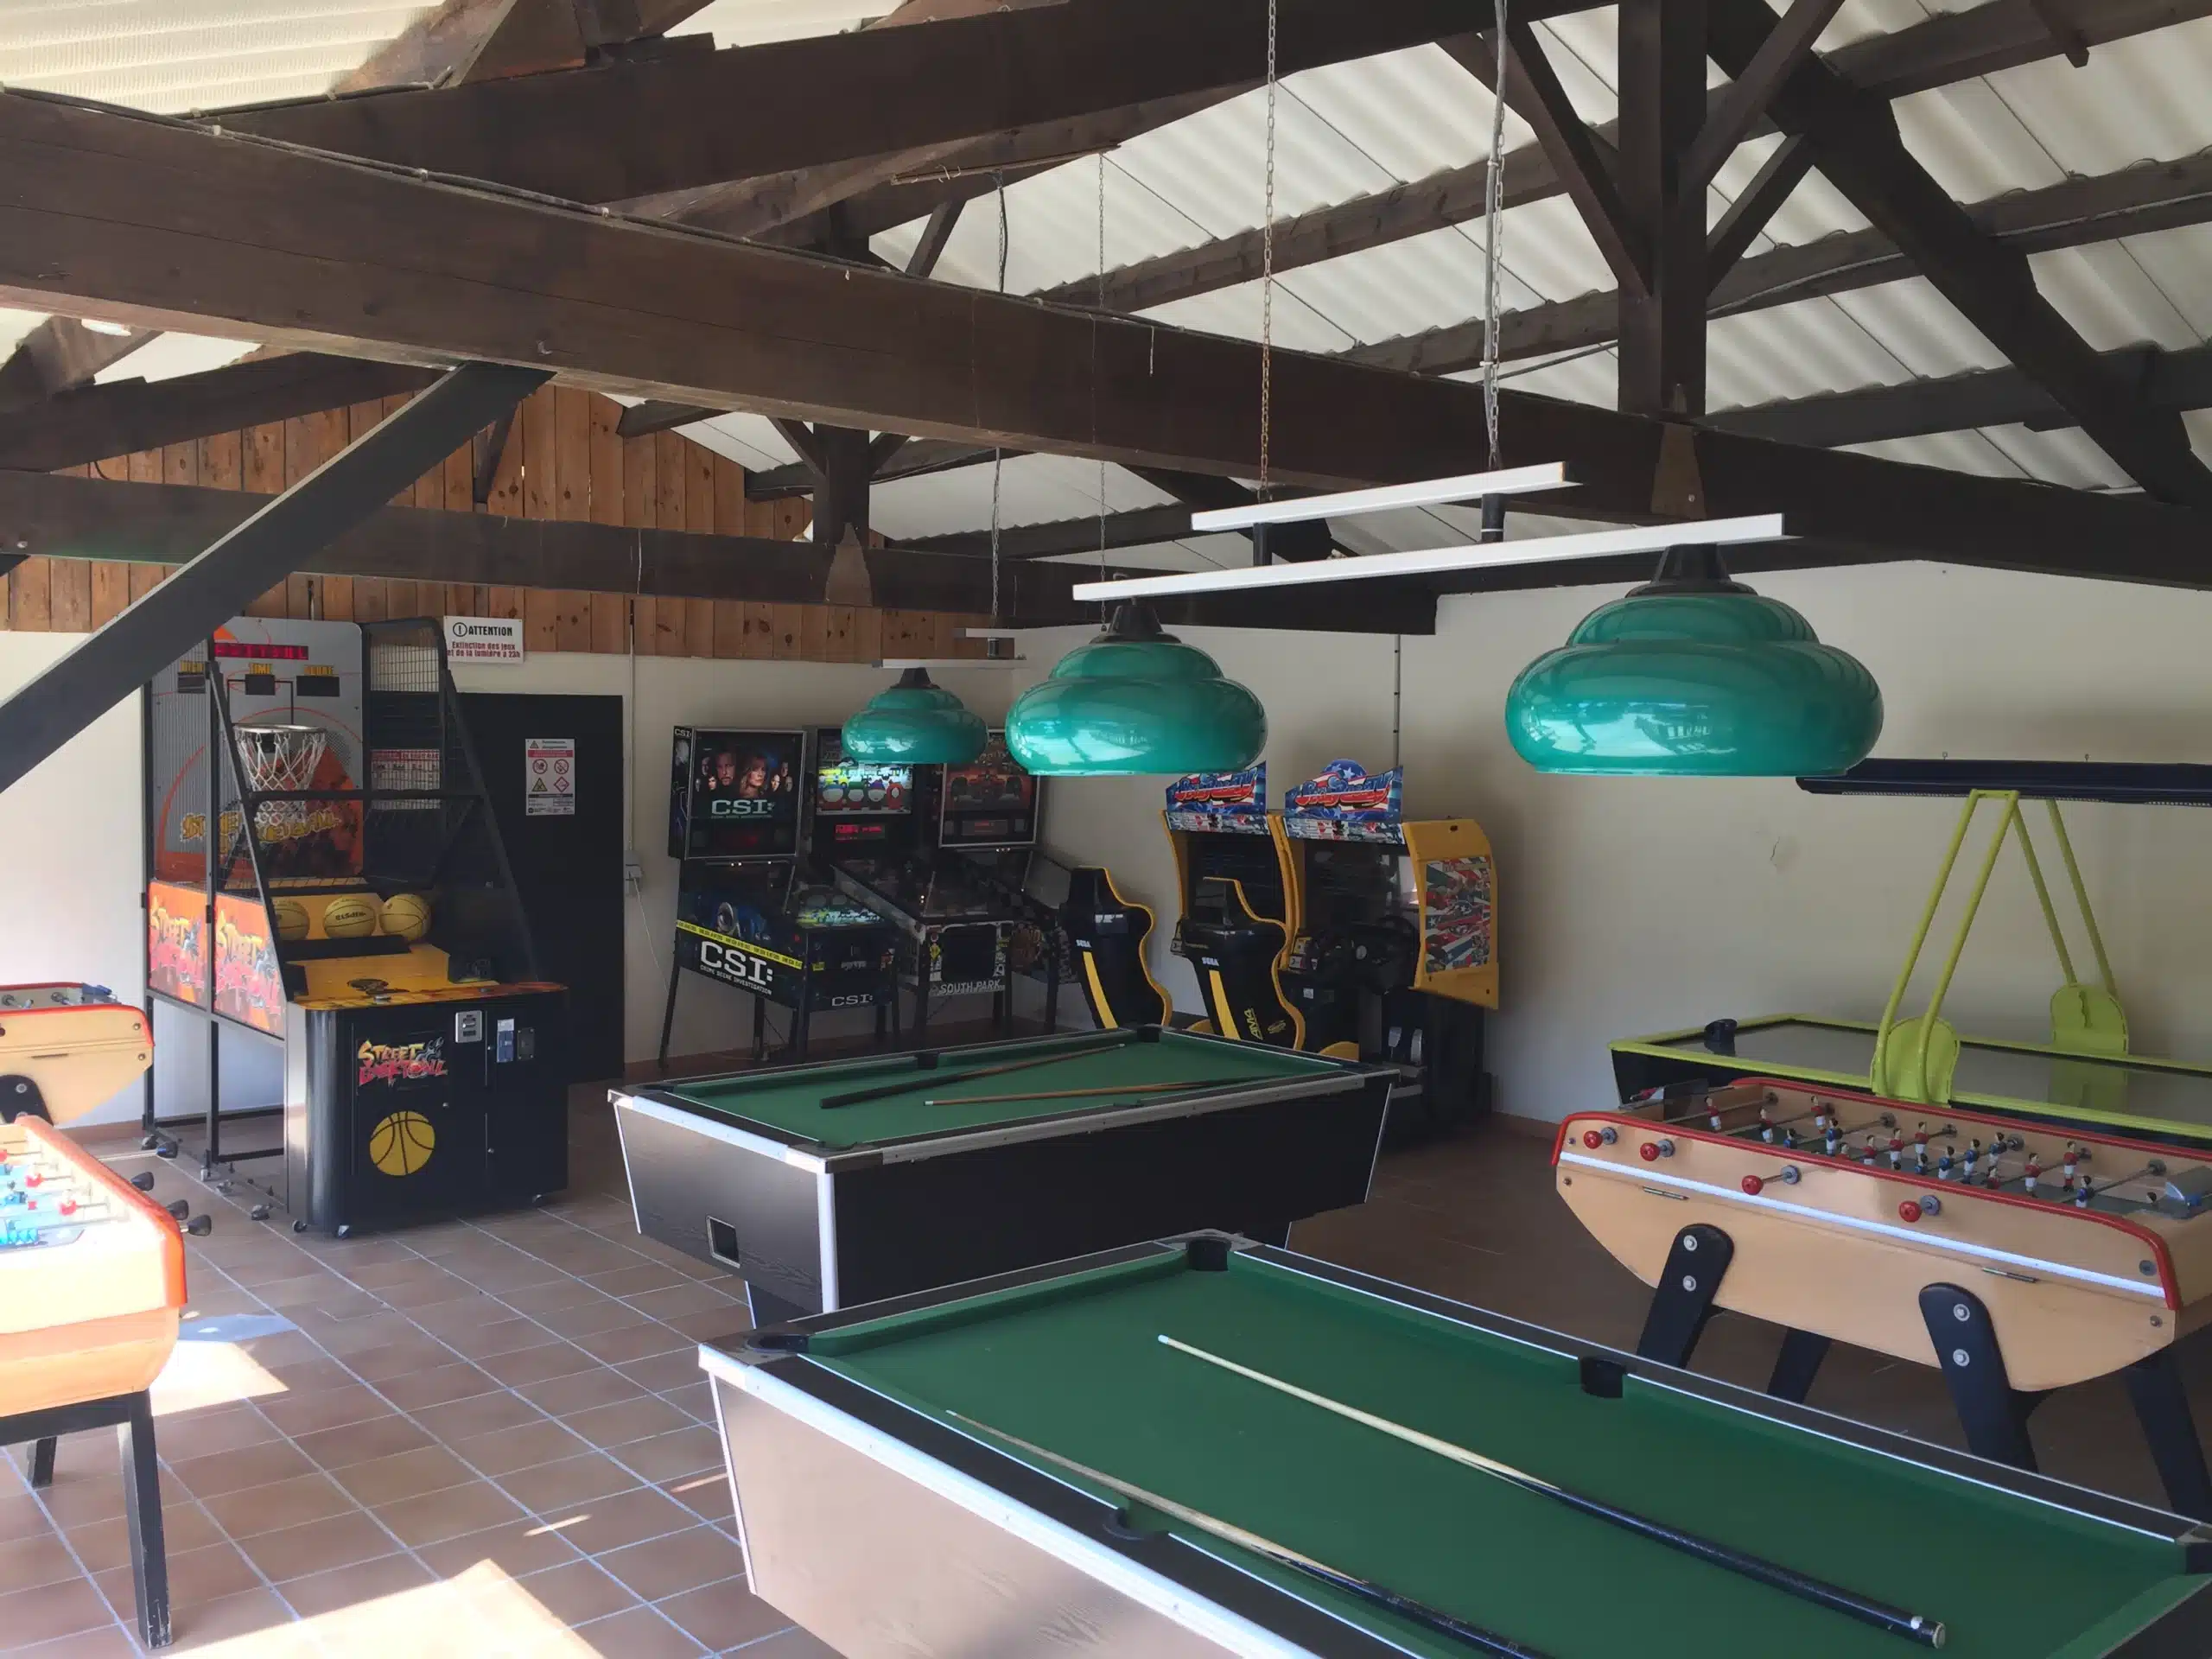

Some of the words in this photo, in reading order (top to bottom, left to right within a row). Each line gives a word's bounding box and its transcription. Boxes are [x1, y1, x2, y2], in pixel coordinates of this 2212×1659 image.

[468, 626, 512, 636] ATTENTION
[701, 941, 773, 986] CSI:
[700, 964, 715, 975] CRIME
[716, 970, 733, 982] SCENE
[734, 976, 772, 995] INVESTIGATION
[940, 982, 973, 995] SOUTH
[976, 979, 1001, 991] PARK
[358, 1039, 425, 1062] STREET
